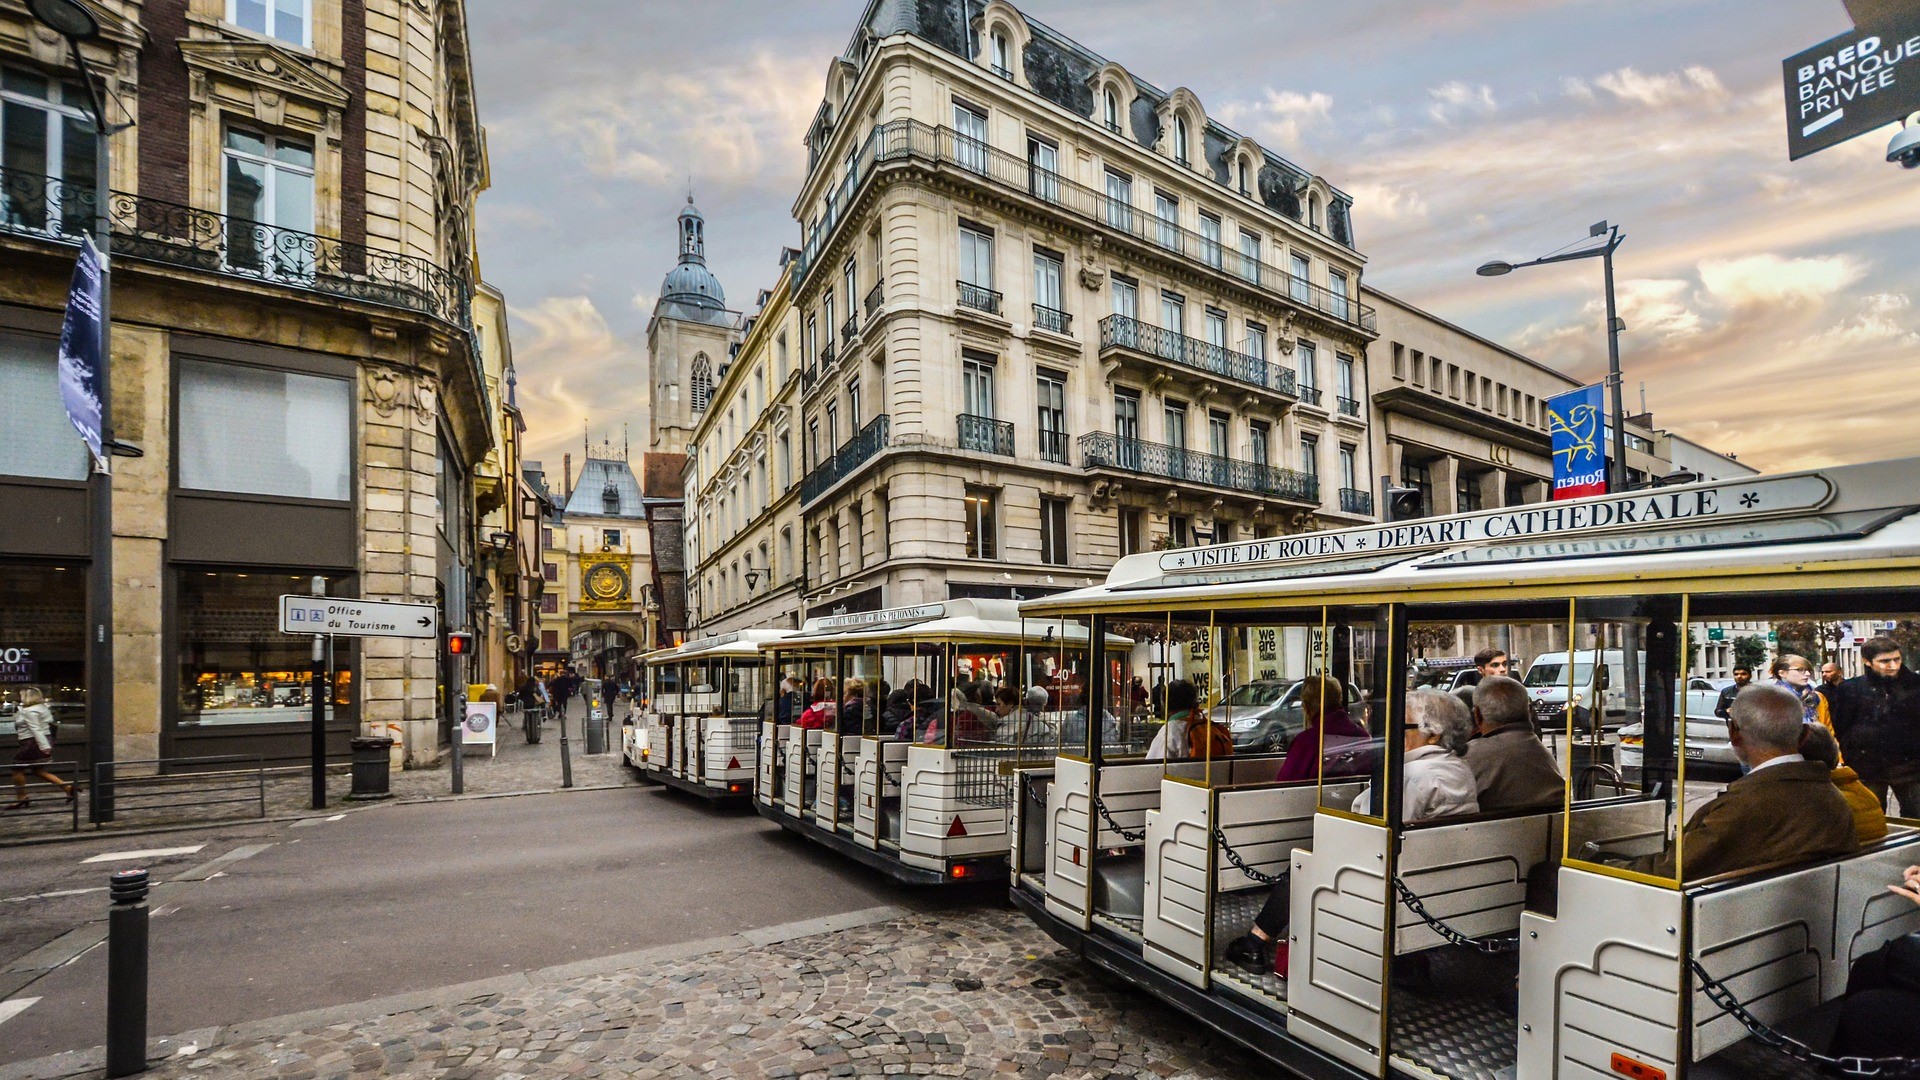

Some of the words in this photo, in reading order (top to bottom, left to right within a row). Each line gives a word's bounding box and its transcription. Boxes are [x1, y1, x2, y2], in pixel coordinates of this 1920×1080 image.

[1798, 36, 1881, 83] BRED
[1799, 35, 1920, 101] BANQUE
[1800, 66, 1896, 119] PRIVÉE
[1490, 443, 1513, 467] LCL
[1191, 546, 1240, 566] VISITE
[1248, 543, 1271, 561] DE
[1279, 534, 1346, 558] ROUEN
[1377, 518, 1472, 549] DEPART
[1484, 488, 1719, 539] CATHEDRALE
[328, 605, 362, 616] Office
[328, 619, 341, 628] du
[348, 619, 396, 631] Tourisme
[1258, 629, 1275, 641] we
[1190, 641, 1210, 653] are
[1258, 641, 1276, 652] are
[1261, 668, 1277, 681] we
